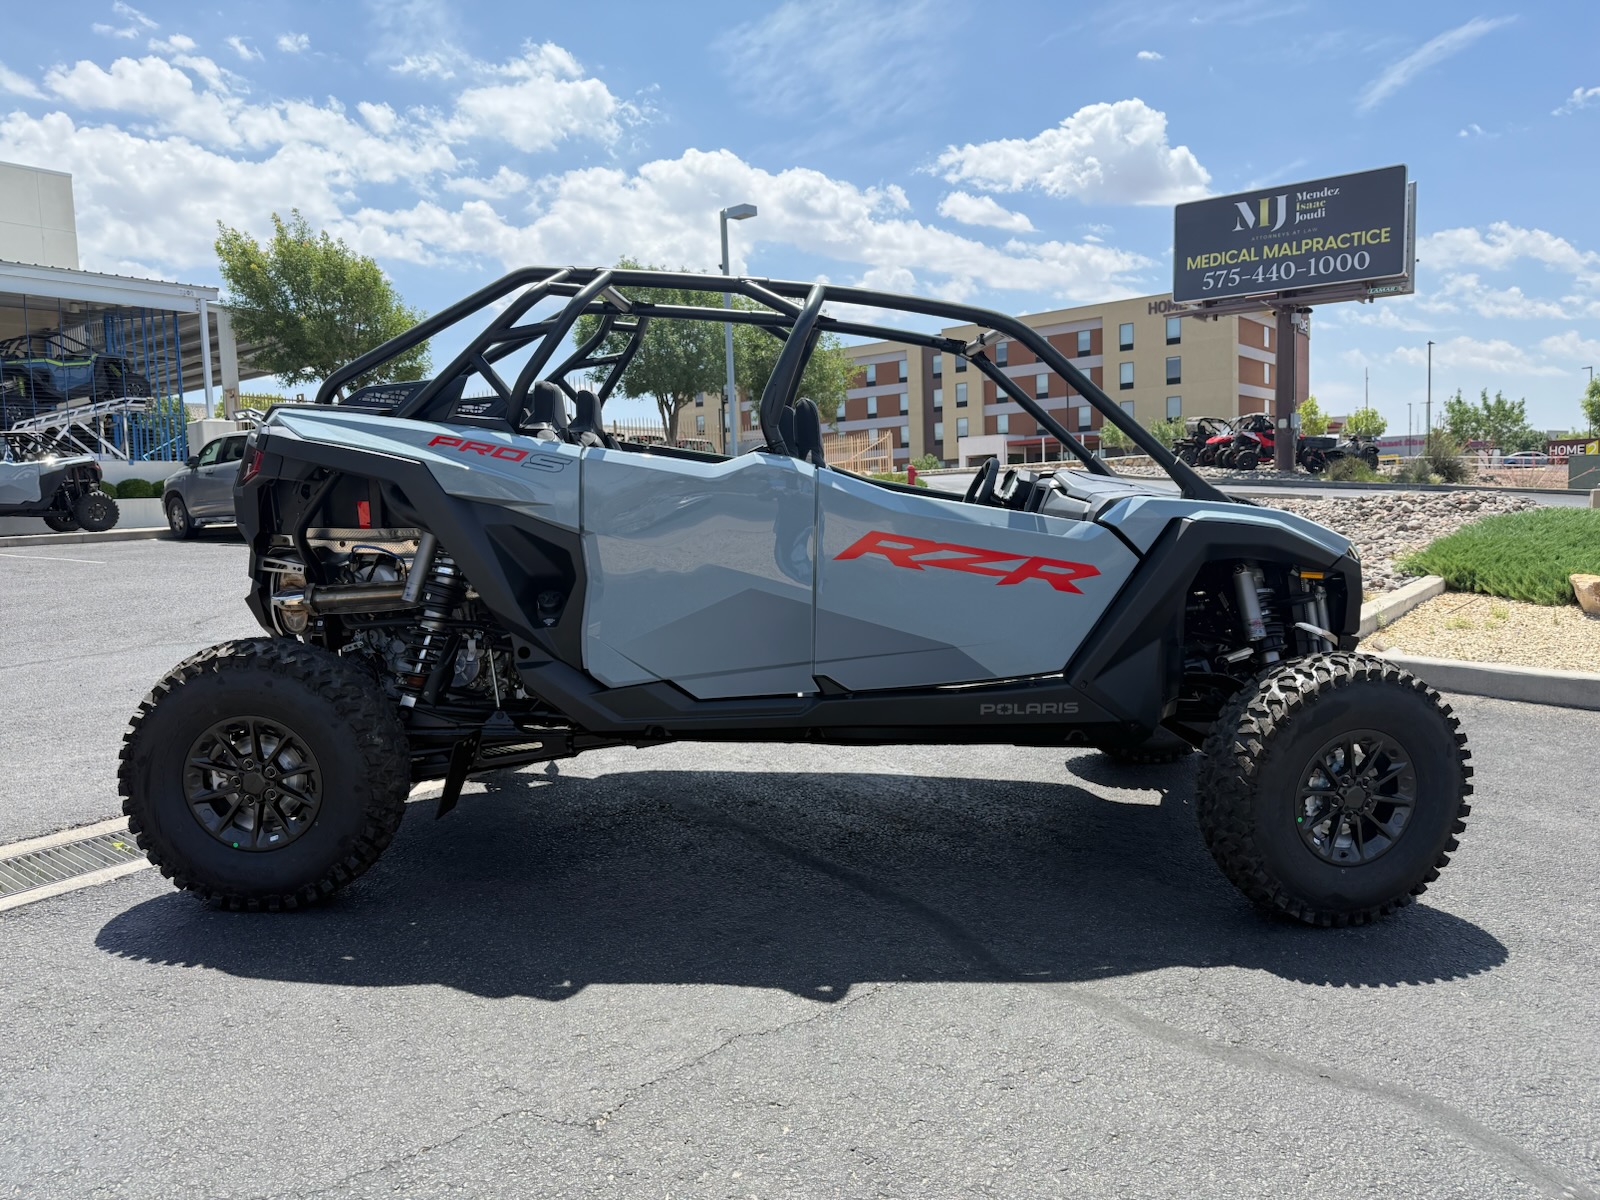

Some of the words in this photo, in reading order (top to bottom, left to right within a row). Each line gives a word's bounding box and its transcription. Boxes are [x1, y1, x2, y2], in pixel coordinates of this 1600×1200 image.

[1296, 186, 1340, 202] Mendez
[1296, 199, 1326, 212] Isaac
[1294, 207, 1326, 225] Joudi
[1251, 231, 1290, 242] ATTORNEYS
[1303, 226, 1319, 235] LAW
[1186, 248, 1259, 271] MEDICAL
[1263, 227, 1391, 260] MALPRACTICE
[1202, 250, 1371, 291] 575-440-1000
[427, 435, 529, 463] PRO
[521, 453, 573, 473] S
[1549, 443, 1585, 456] HOME
[832, 530, 1102, 594] RZR
[980, 702, 1079, 715] POLARIS
